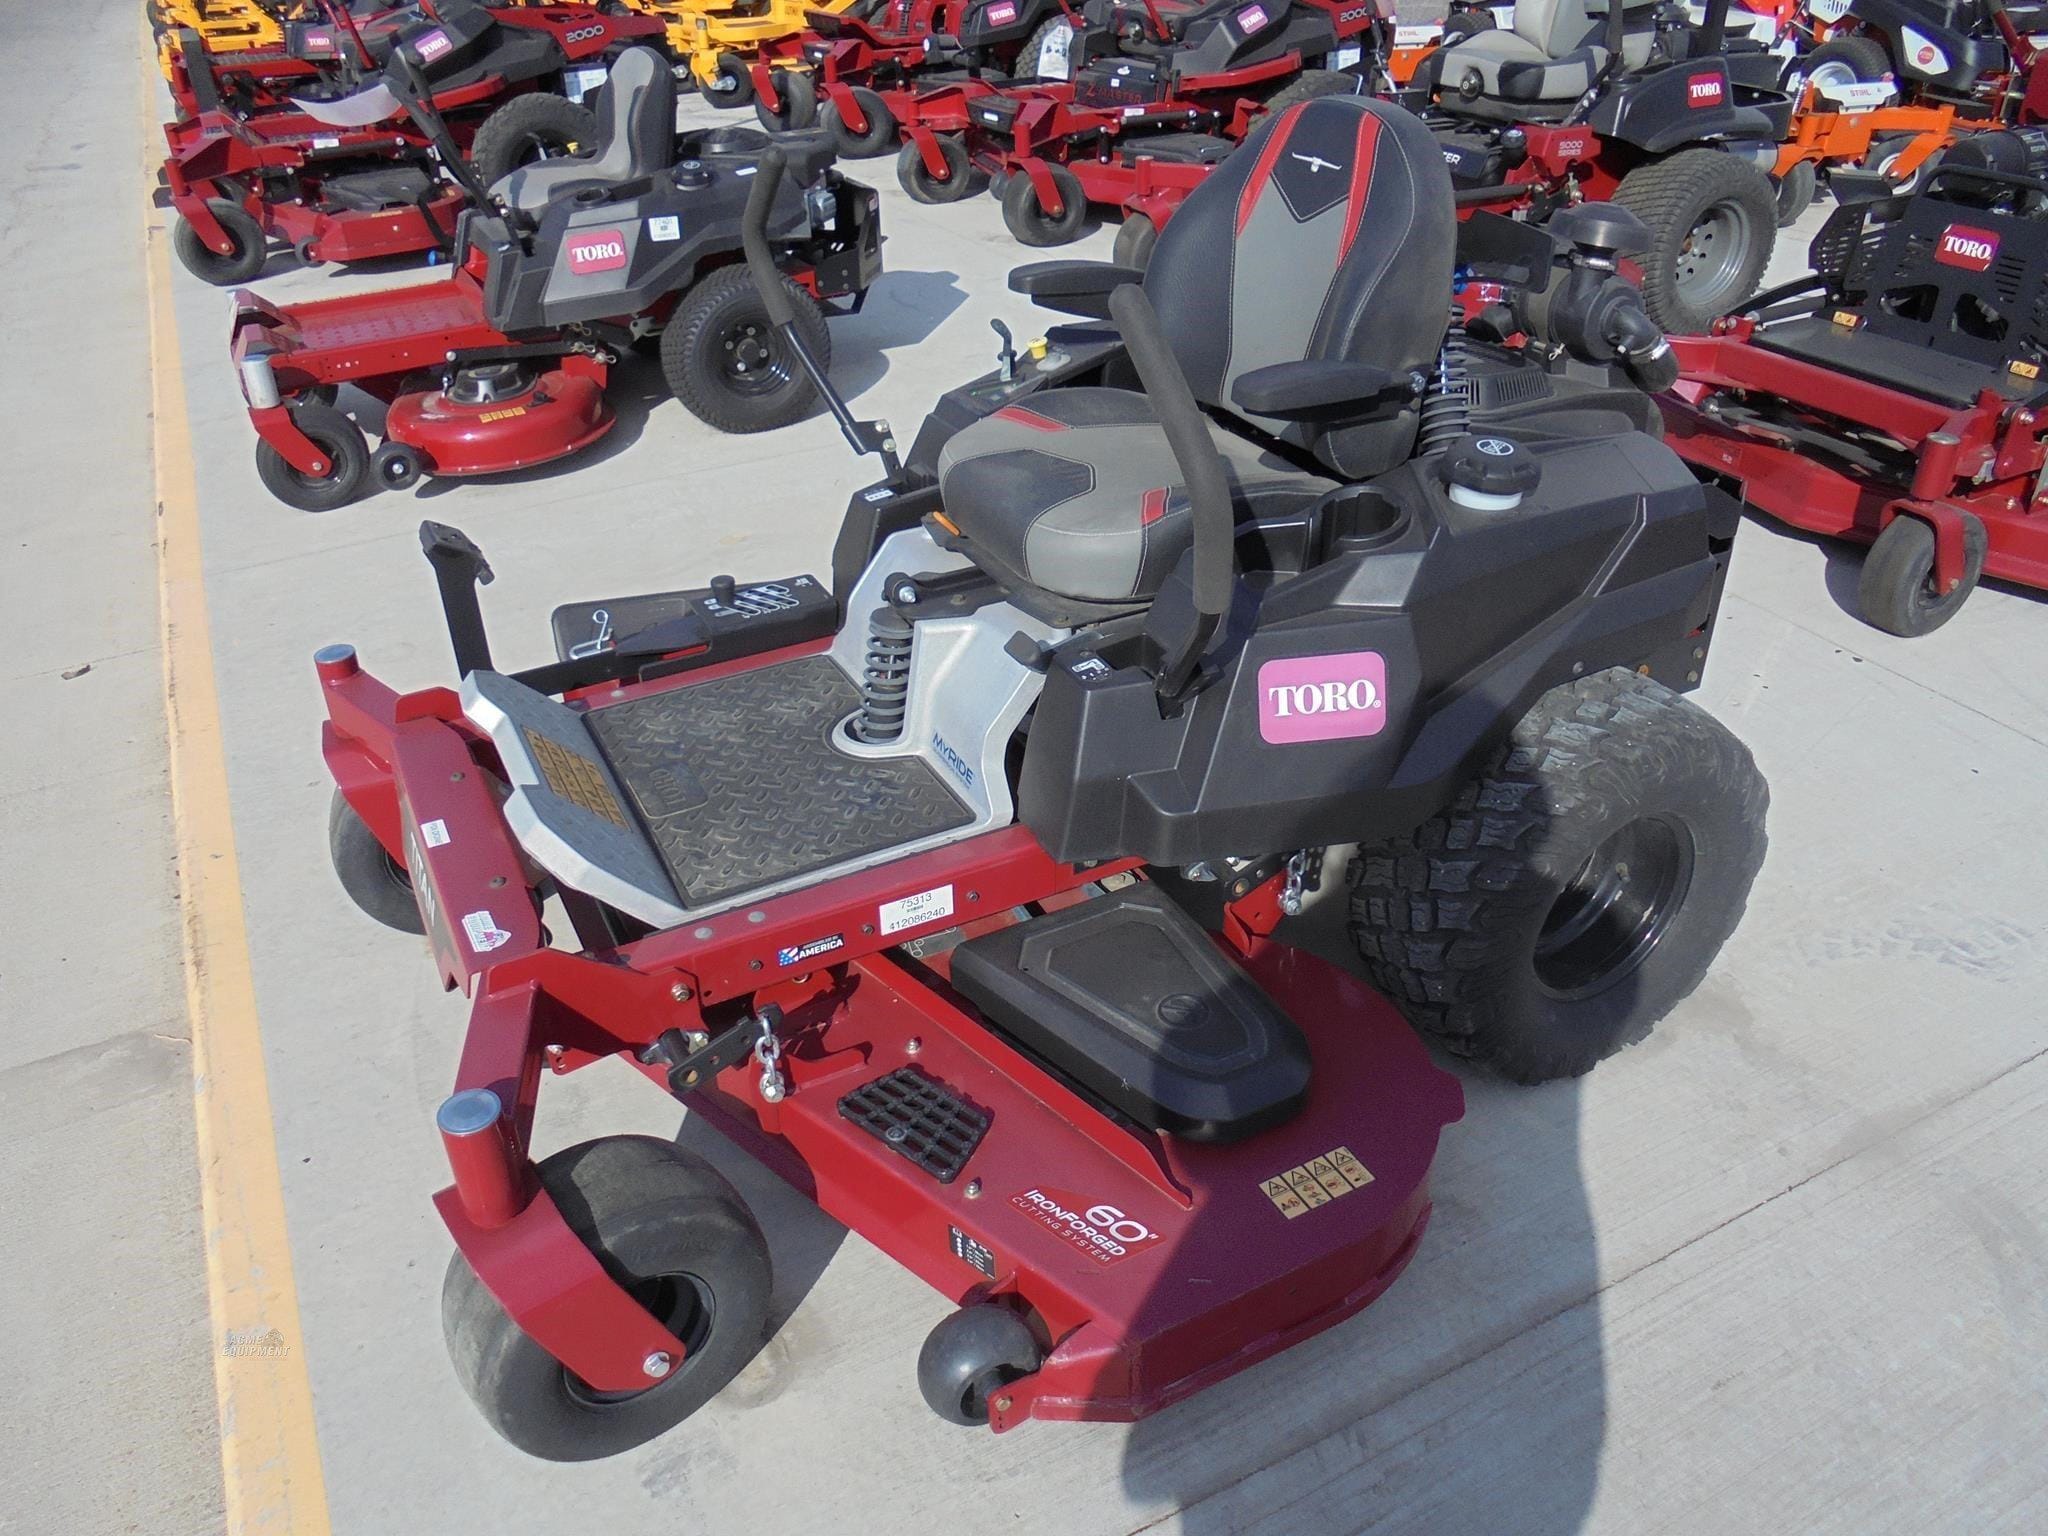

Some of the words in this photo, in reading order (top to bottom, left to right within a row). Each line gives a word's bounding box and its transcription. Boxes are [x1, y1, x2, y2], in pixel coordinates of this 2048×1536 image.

[990, 7, 1015, 21] TORO
[1243, 12, 1263, 28] TORO
[308, 37, 330, 46] TORO
[566, 25, 604, 43] 2000
[421, 36, 448, 56] TORO
[1690, 82, 1720, 98] TORO
[1849, 88, 1873, 97] STIHL
[572, 242, 624, 263] TORO
[1944, 235, 1992, 260] TORO
[1268, 679, 1381, 717] TORO
[932, 732, 974, 785] MYRIDE
[410, 831, 435, 928] TITAN
[901, 892, 933, 910] 75313
[889, 906, 946, 931] 412086240
[799, 938, 844, 959] AMERICA
[1011, 1196, 1061, 1230] CUTTING
[1062, 1229, 1111, 1262] SYSTEM
